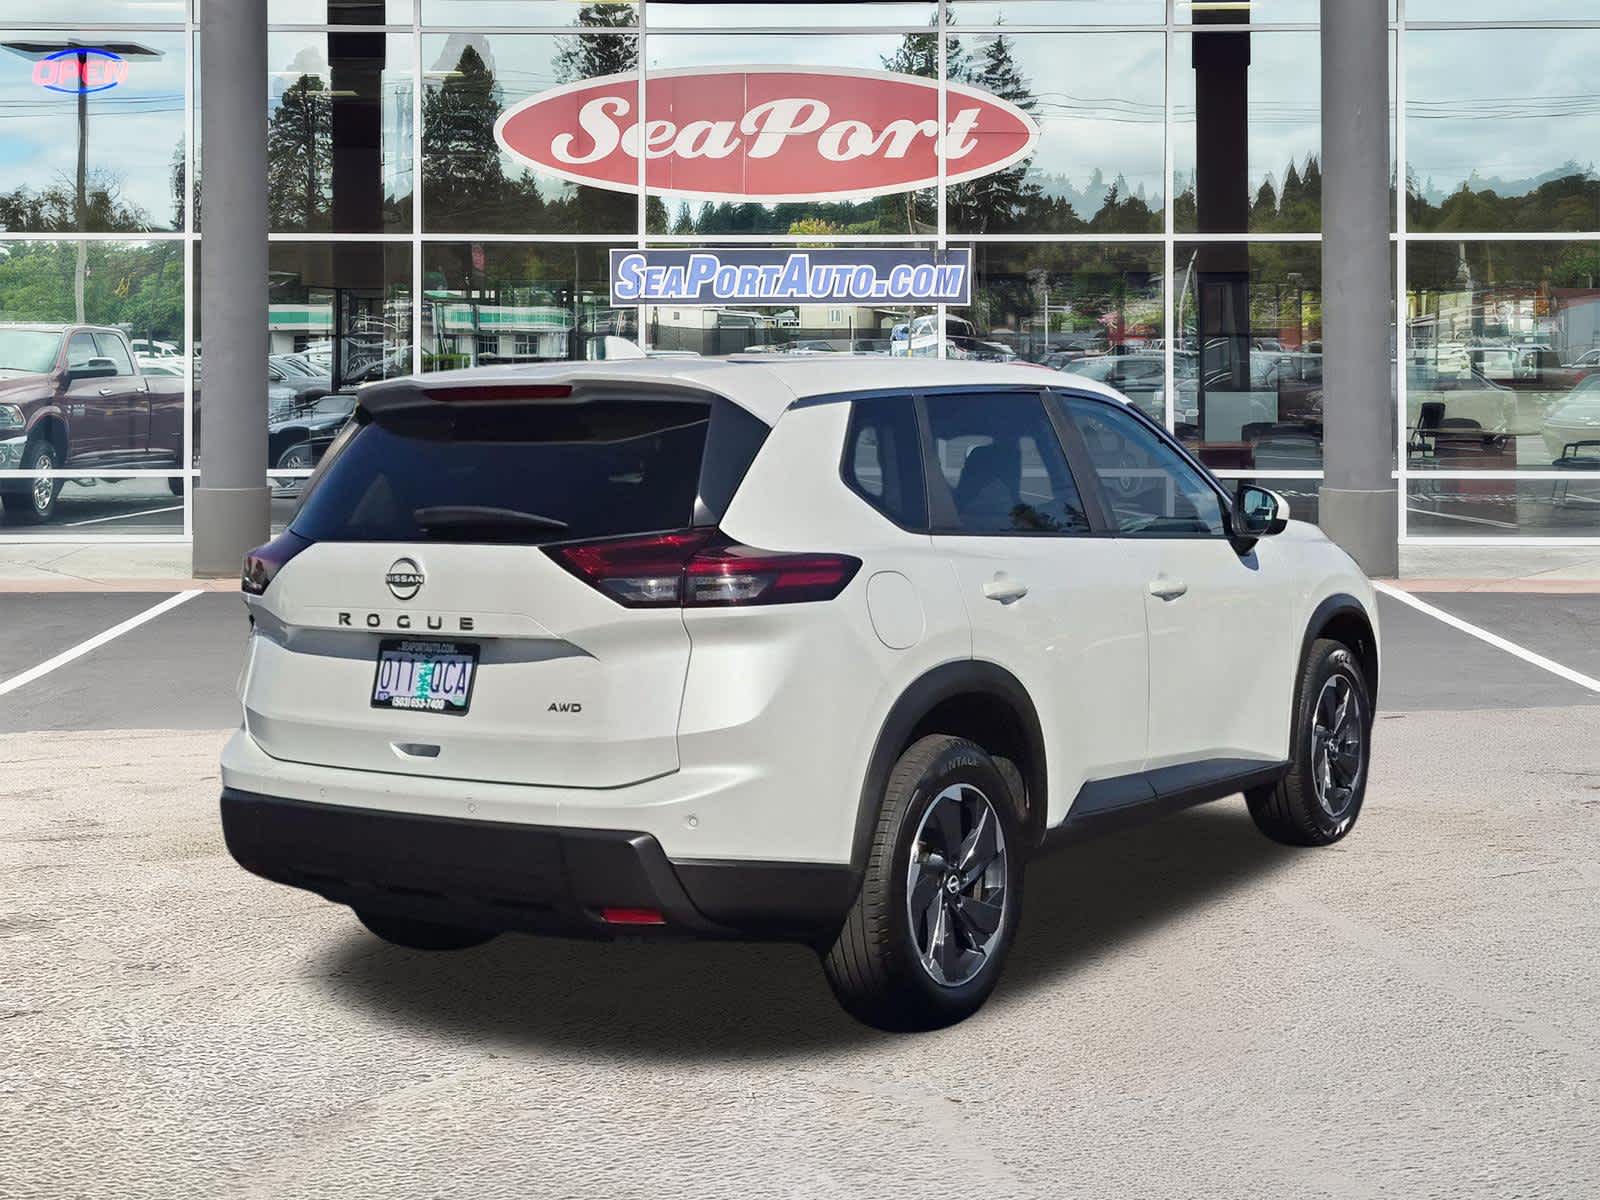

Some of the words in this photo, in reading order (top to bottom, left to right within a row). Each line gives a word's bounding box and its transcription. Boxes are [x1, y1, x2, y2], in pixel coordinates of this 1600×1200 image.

[32, 60, 128, 86] OPEN
[550, 96, 982, 164] SeaPort
[386, 575, 424, 583] NISSAN
[338, 612, 474, 631] ROGUE
[430, 659, 467, 695] QCA
[547, 702, 582, 713] AWD
